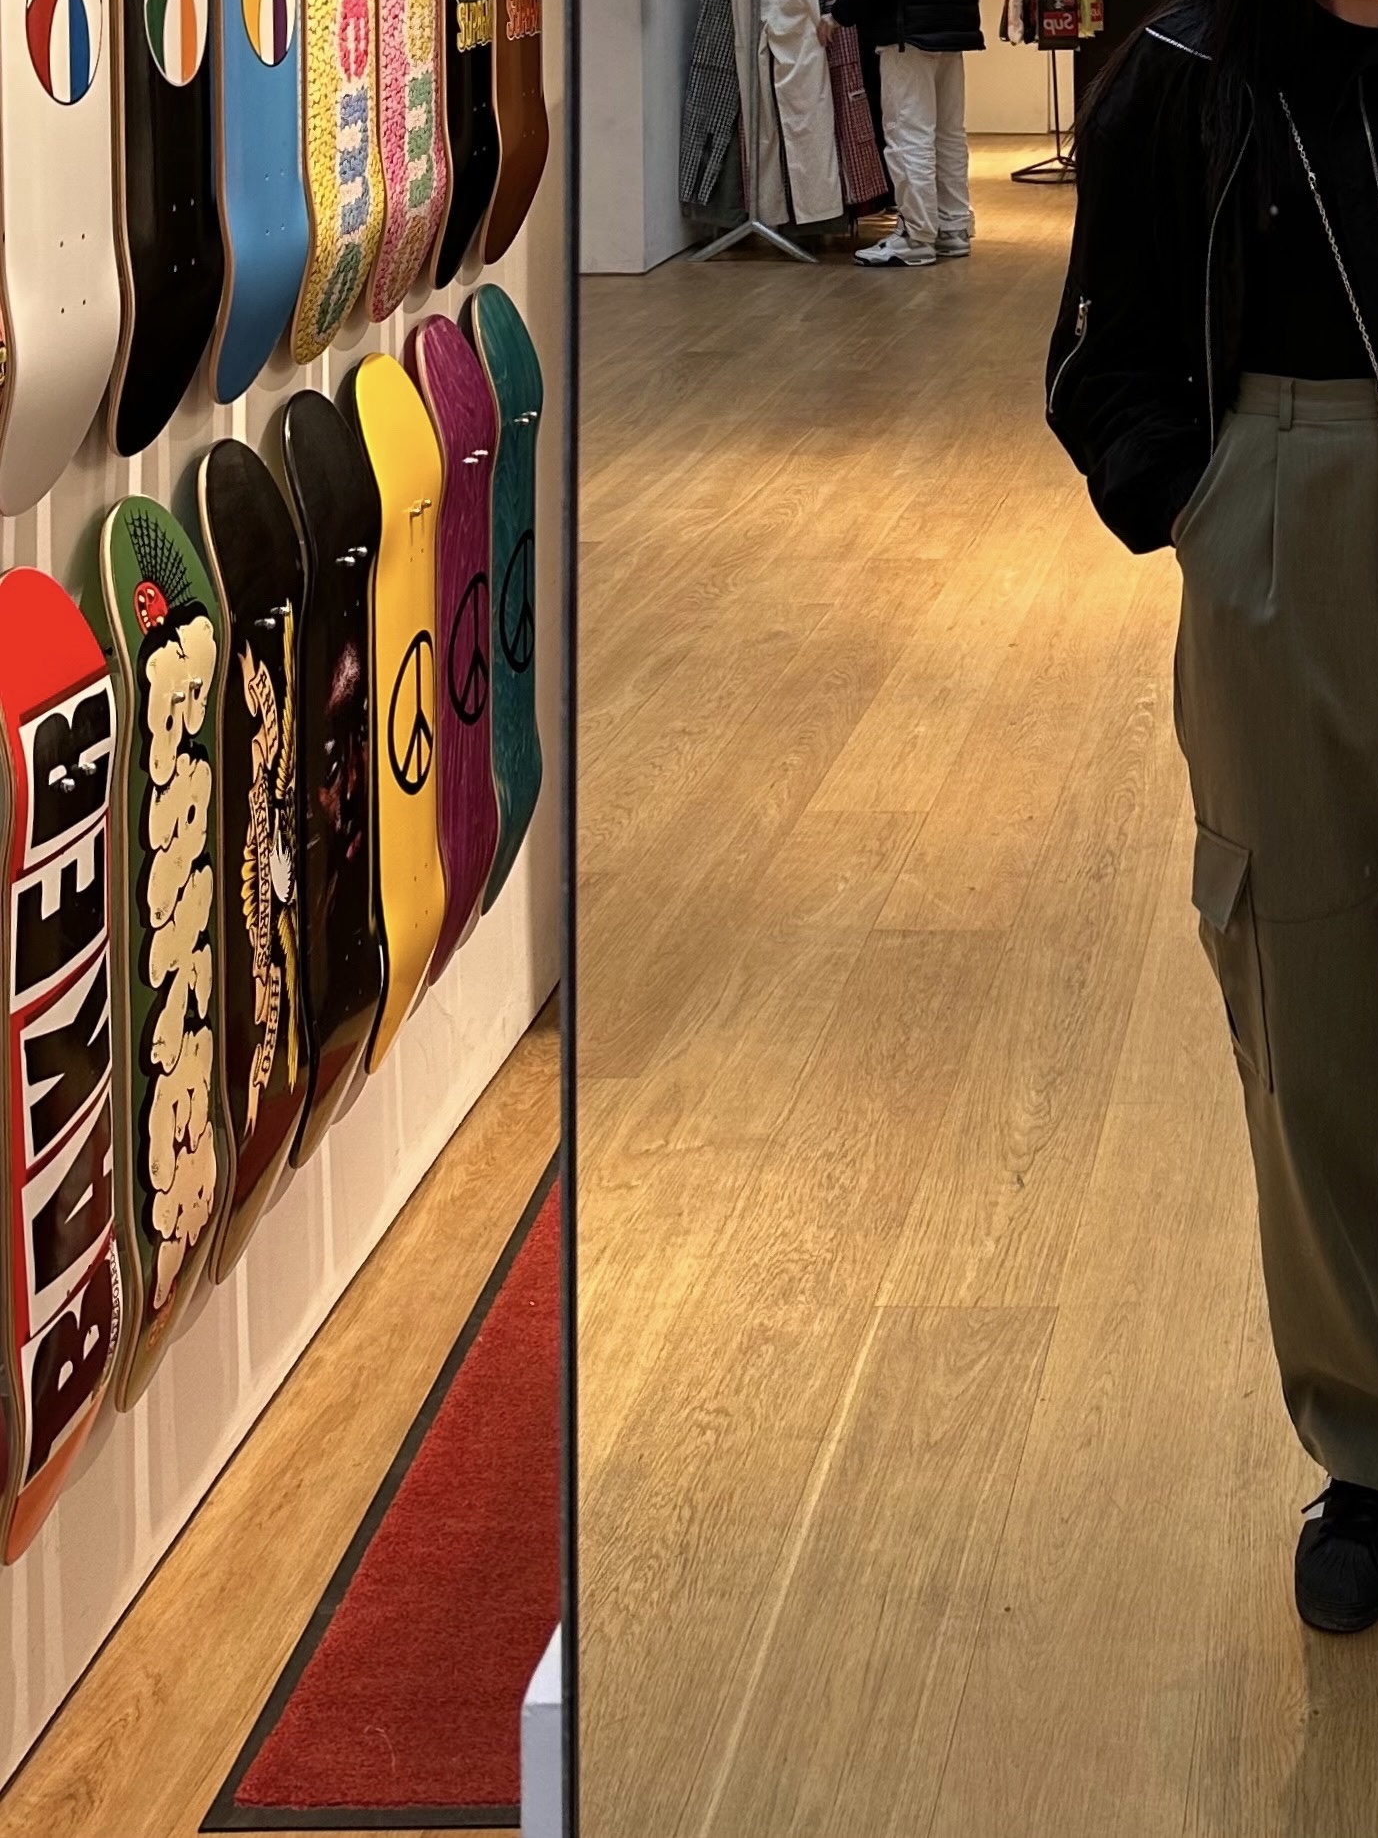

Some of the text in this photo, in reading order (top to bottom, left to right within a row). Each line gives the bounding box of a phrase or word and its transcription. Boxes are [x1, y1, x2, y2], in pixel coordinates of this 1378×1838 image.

[257, 667, 279, 753] ANTI
[261, 975, 281, 1076] HERO
[14, 684, 112, 1480] BAKER
